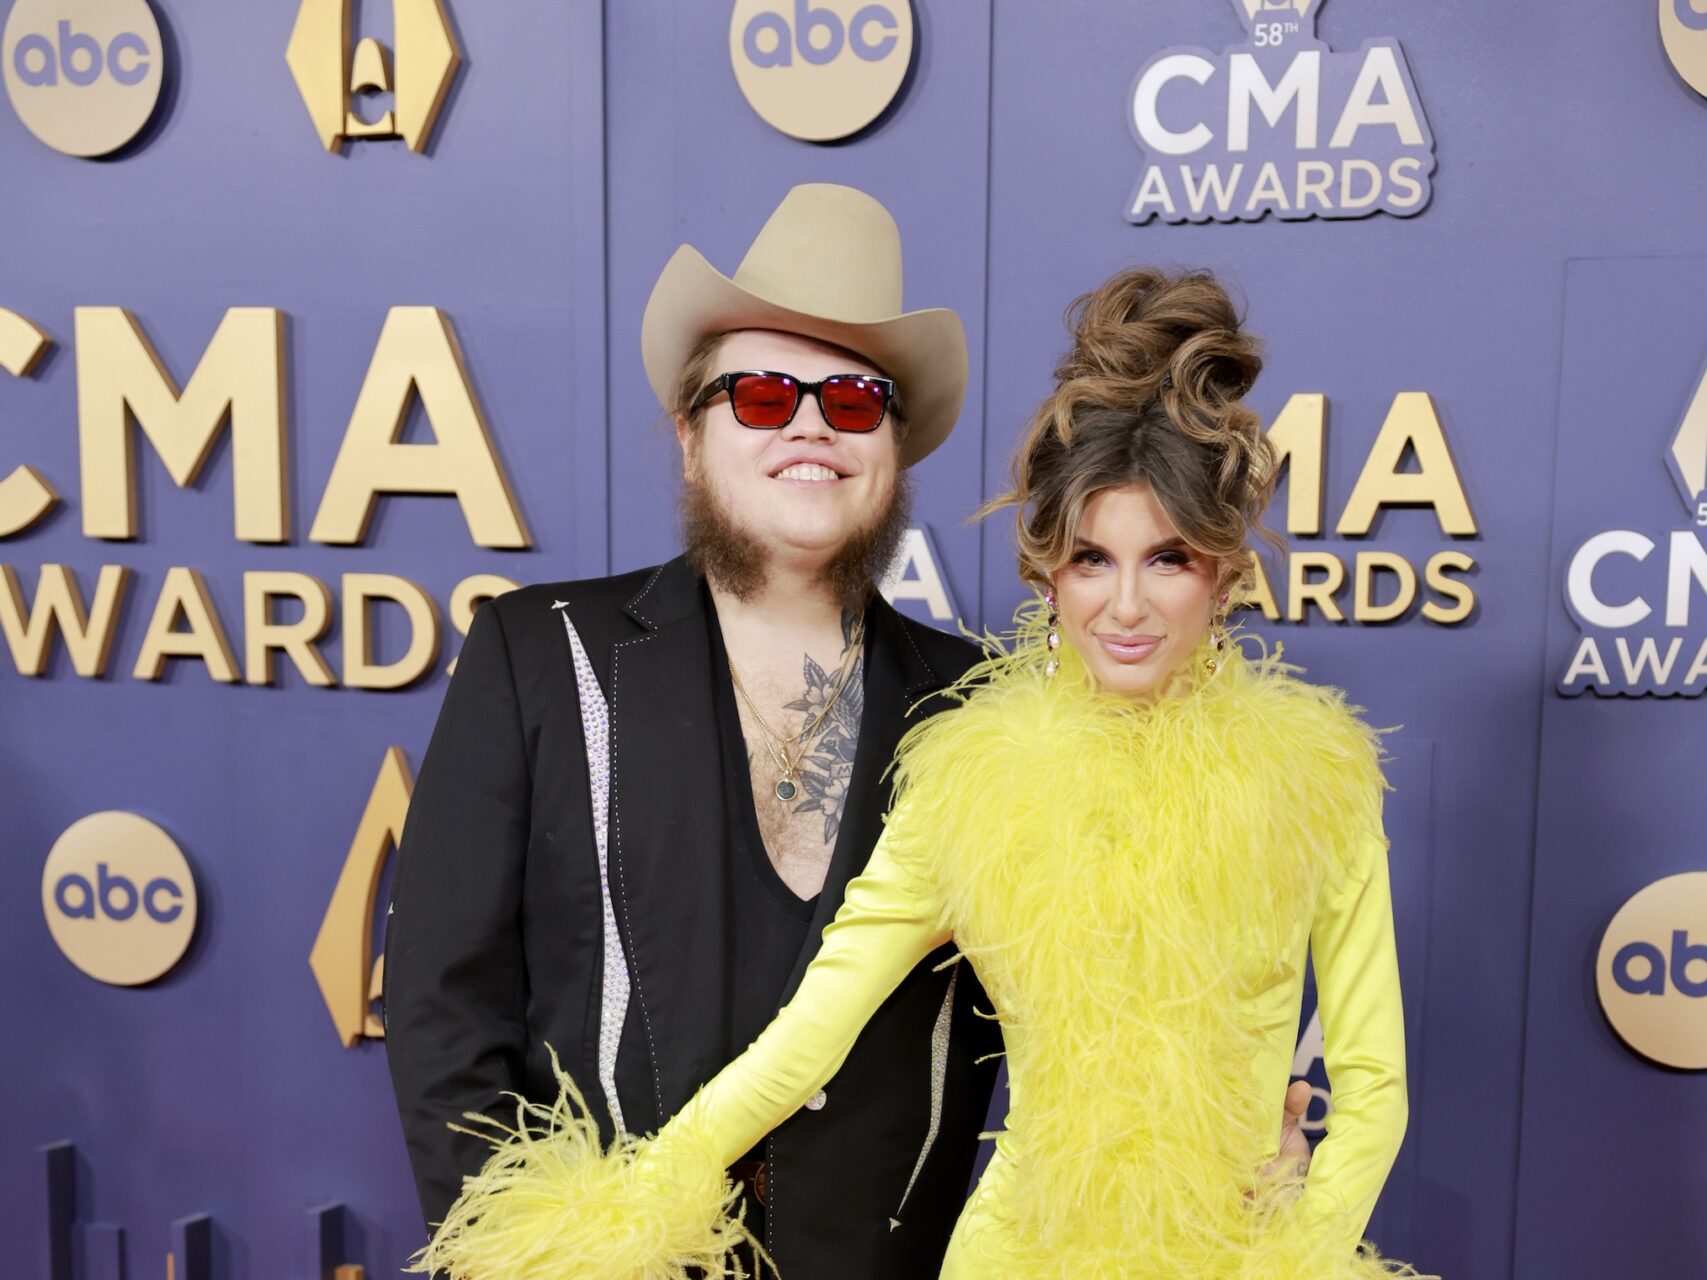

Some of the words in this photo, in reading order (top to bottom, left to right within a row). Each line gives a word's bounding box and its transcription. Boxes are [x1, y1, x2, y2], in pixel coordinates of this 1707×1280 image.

[14, 20, 150, 87] abc
[743, 0, 898, 68] abc
[1254, 22, 1299, 48] 58TH
[1133, 47, 1424, 155] CMA
[1131, 157, 1422, 214] AWARDS
[54, 863, 183, 923] abc
